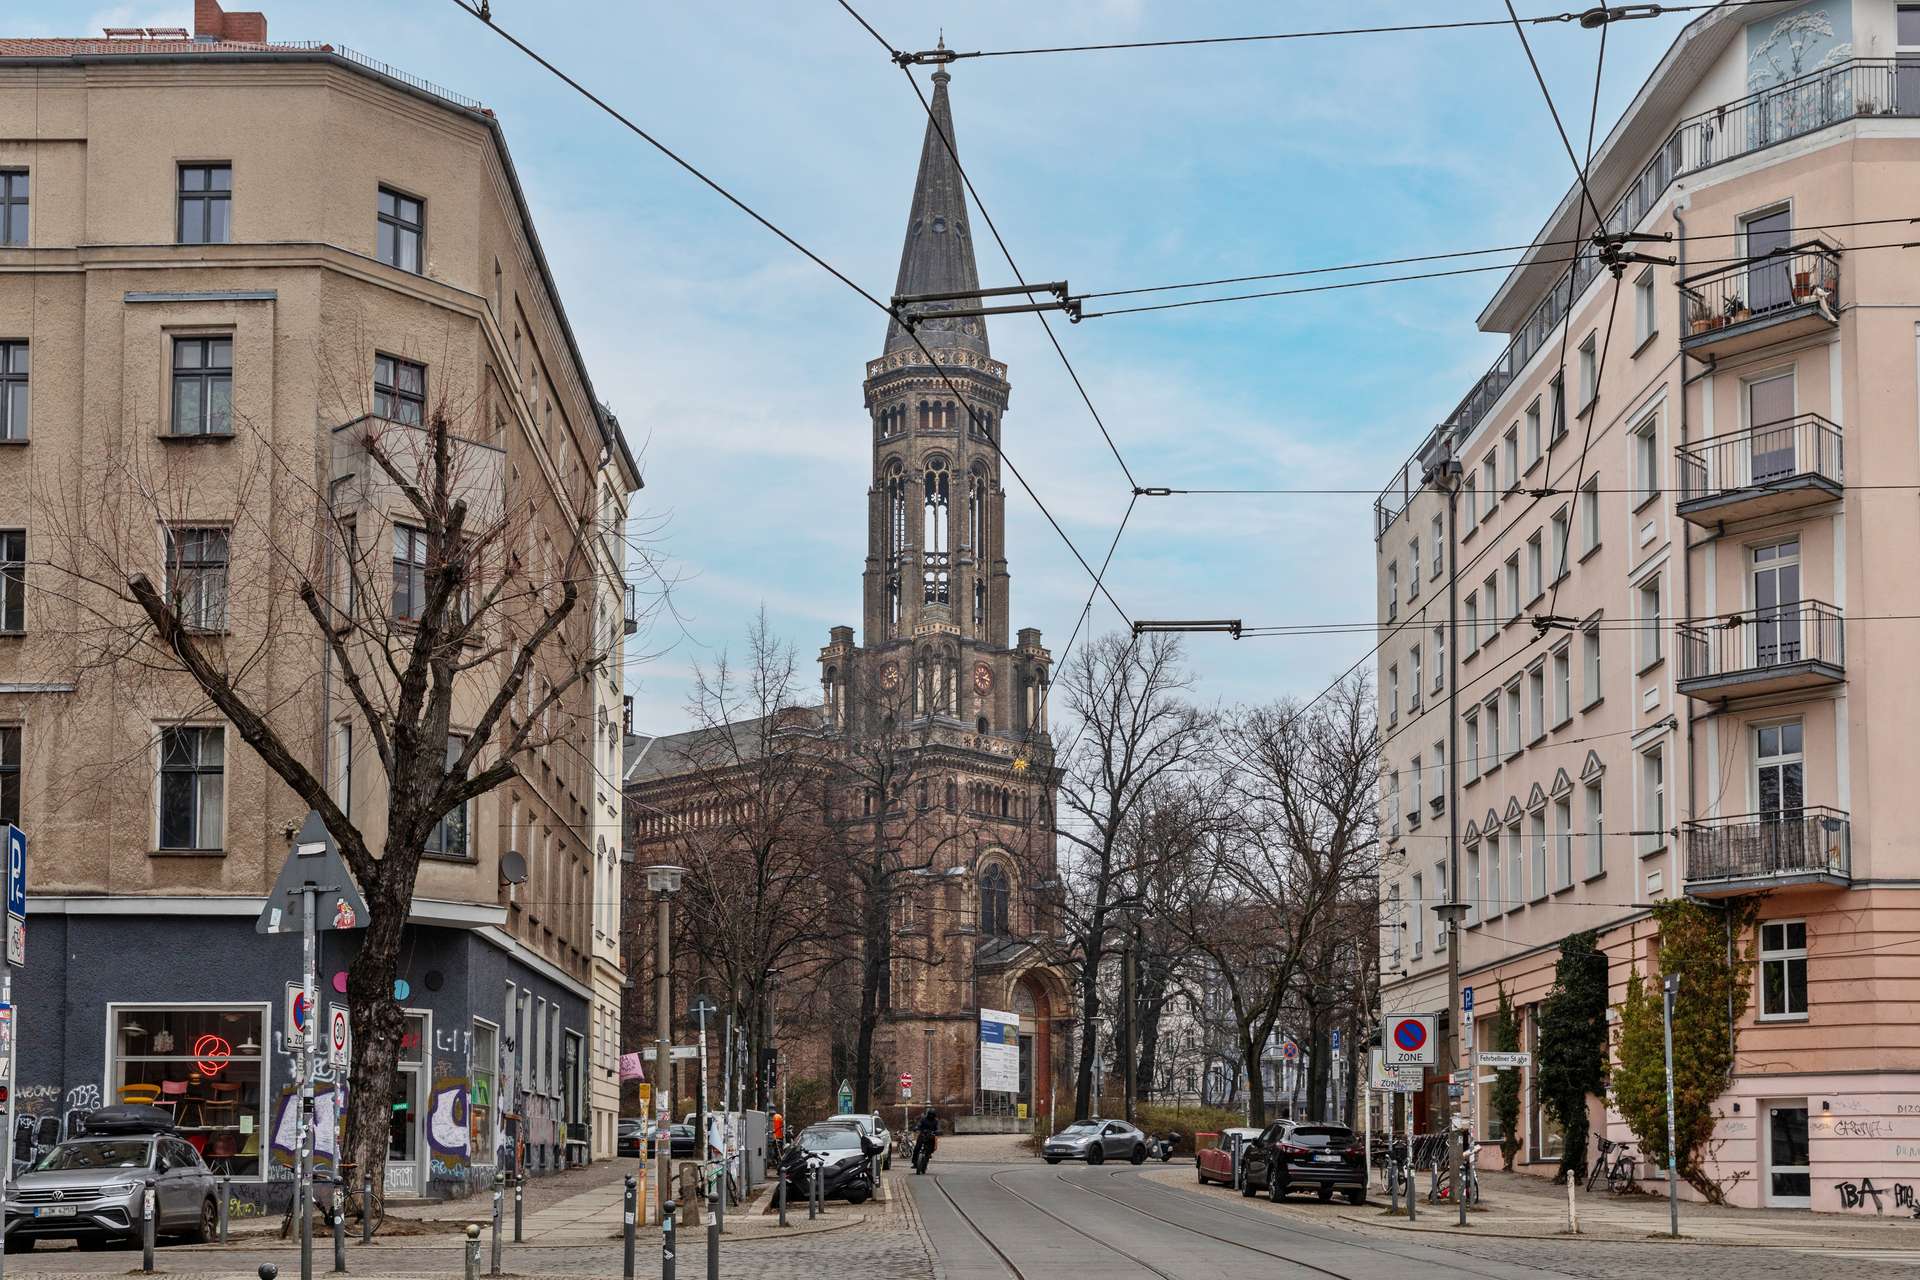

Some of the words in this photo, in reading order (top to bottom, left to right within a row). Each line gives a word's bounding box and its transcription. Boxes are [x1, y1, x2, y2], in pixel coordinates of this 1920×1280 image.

[12, 838, 21, 901] P
[336, 1023, 343, 1039] 30
[1398, 1053, 1423, 1061] ZONE
[1381, 1079, 1397, 1087] ZON
[1834, 1178, 1884, 1215] TBA
